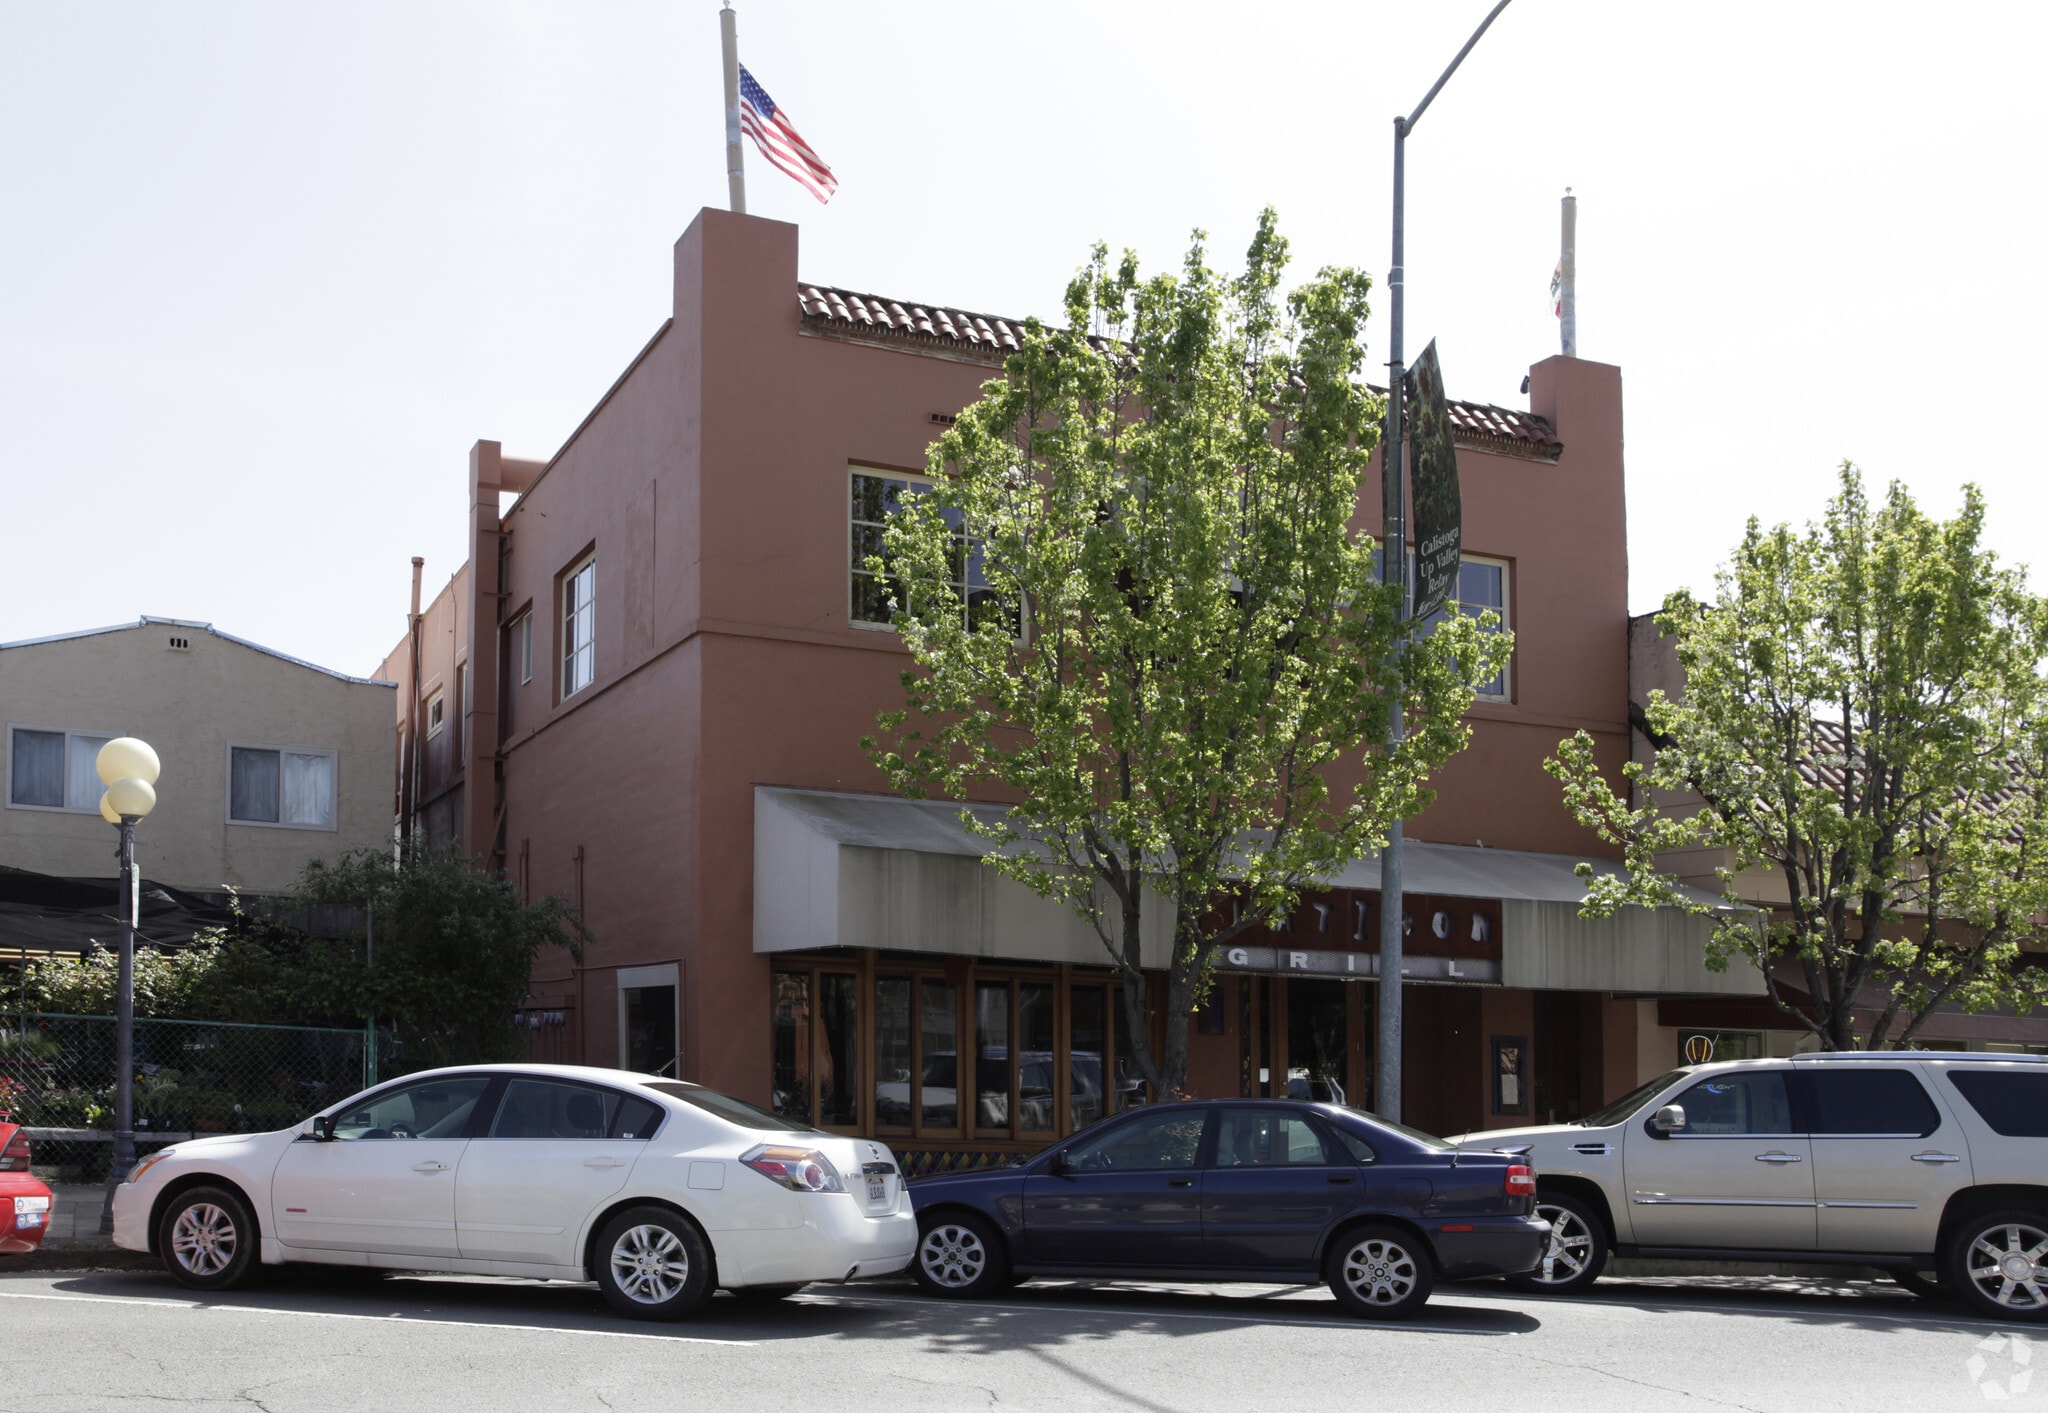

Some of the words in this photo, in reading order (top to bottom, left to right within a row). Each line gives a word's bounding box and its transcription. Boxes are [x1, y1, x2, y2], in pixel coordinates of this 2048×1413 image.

[1421, 527, 1459, 557] Calistoga
[1420, 561, 1434, 579] Up
[1436, 547, 1459, 569] Valley
[1228, 948, 1464, 977] GRIL
